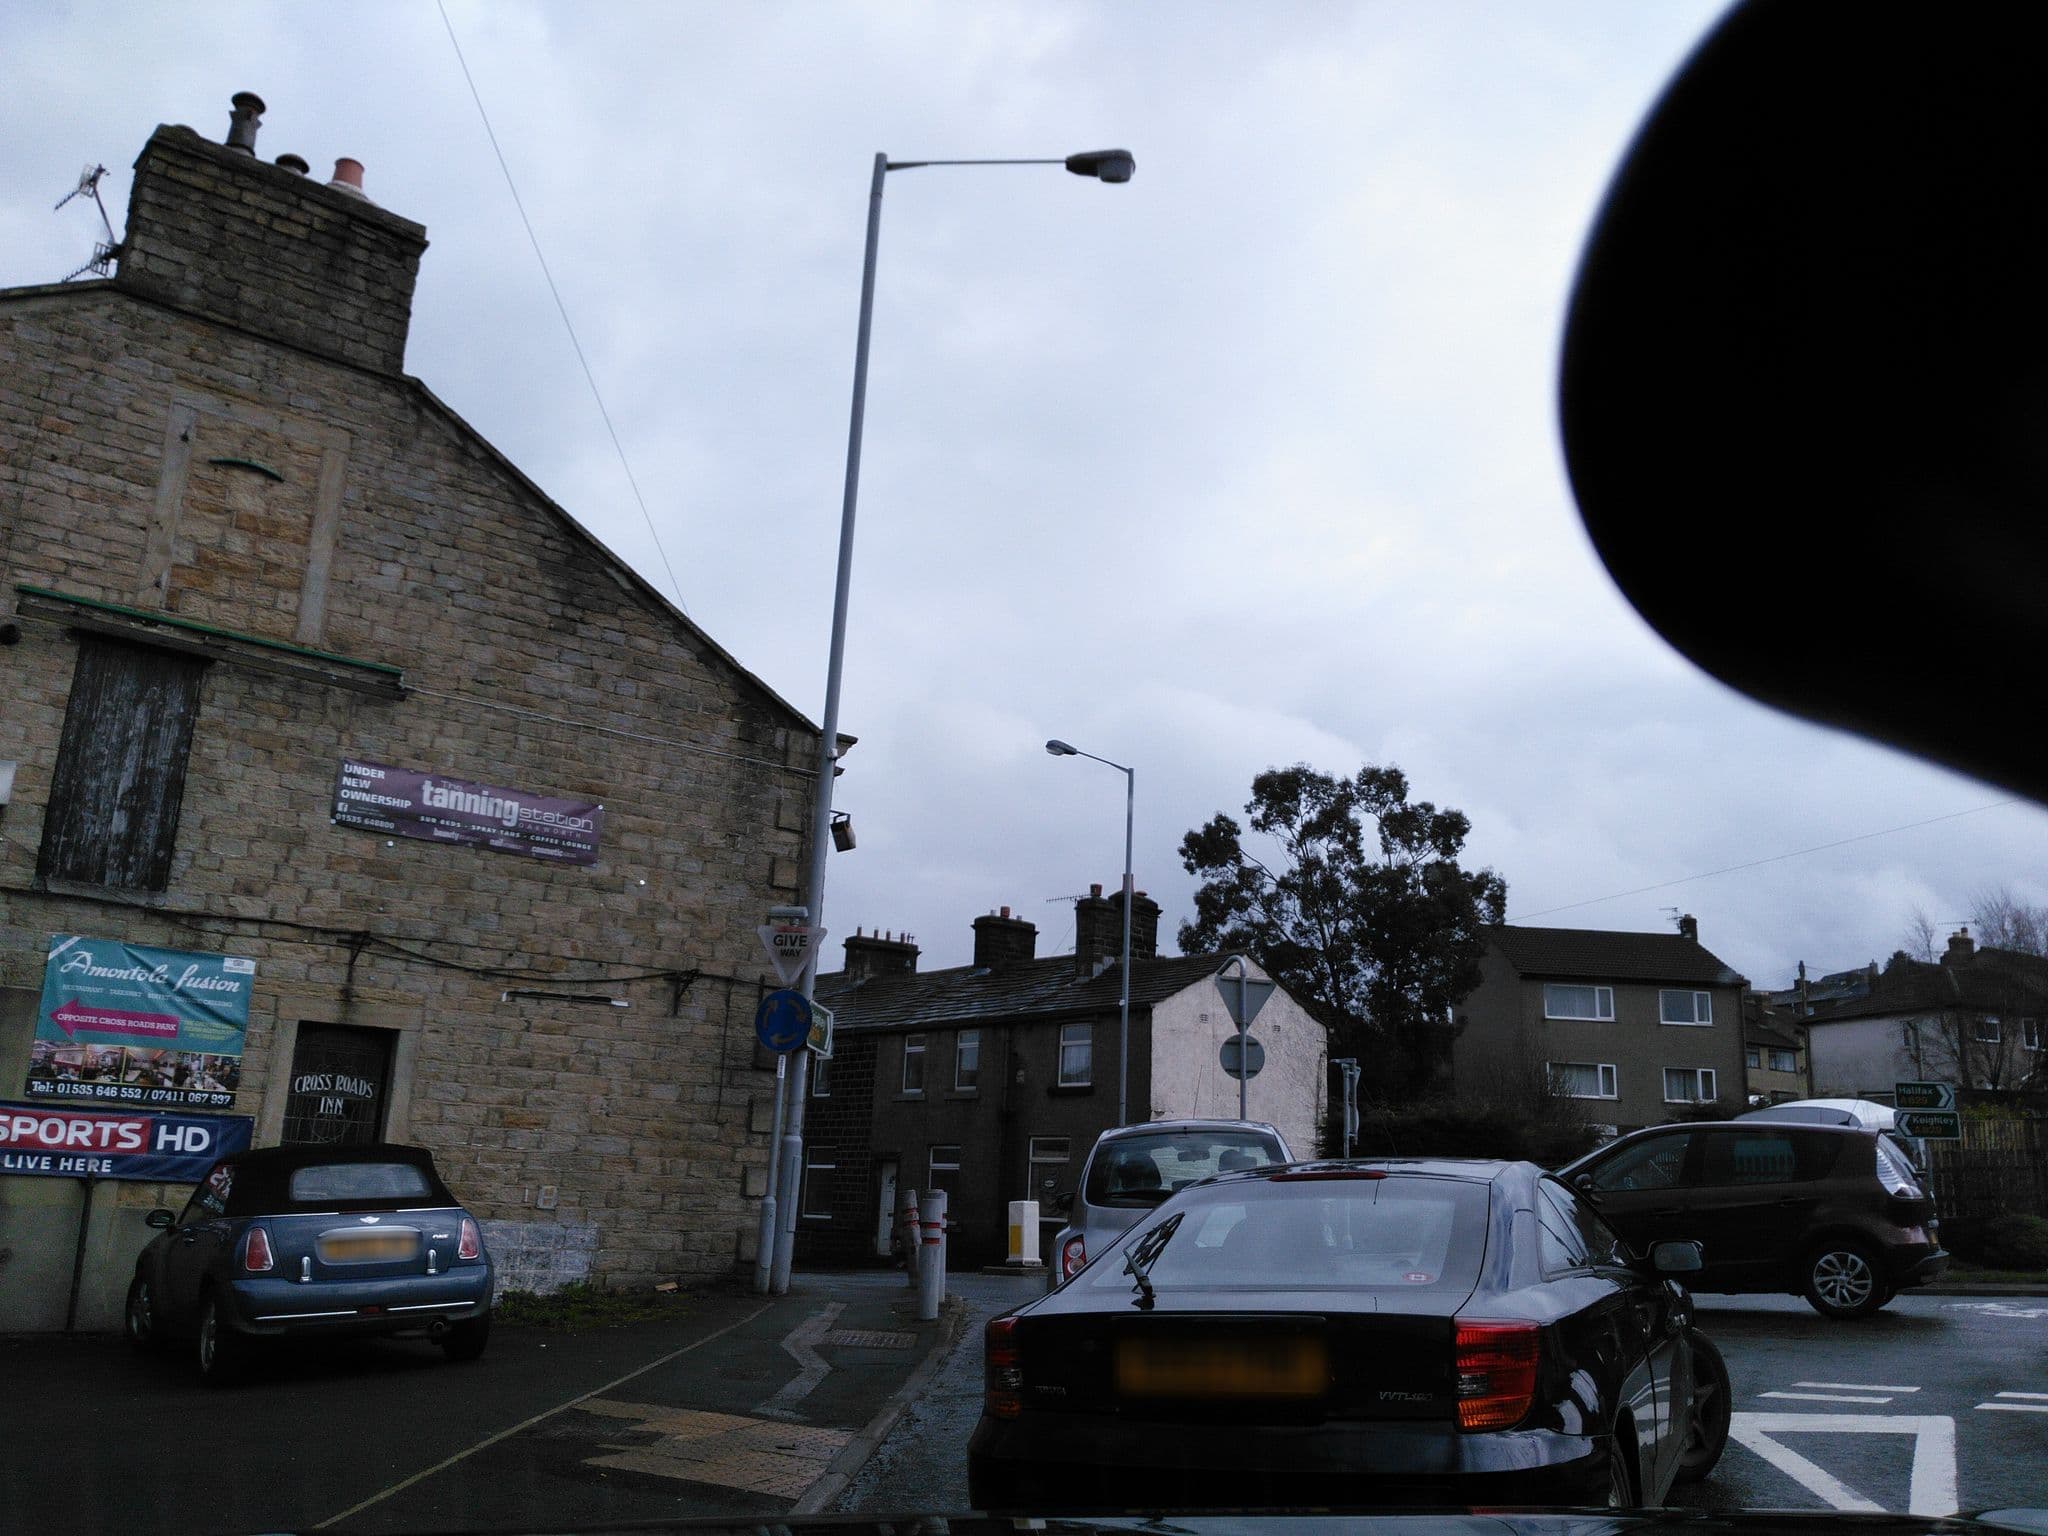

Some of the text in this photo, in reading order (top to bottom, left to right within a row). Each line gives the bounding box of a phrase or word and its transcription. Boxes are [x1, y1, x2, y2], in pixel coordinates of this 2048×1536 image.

[344, 763, 386, 780] UNDER
[342, 776, 372, 789] NEW
[340, 789, 412, 809] OWNERSHIP
[422, 780, 594, 831] tanning station
[530, 834, 560, 845] COFFEE
[562, 840, 592, 851] LOUNGE
[773, 934, 809, 947] GIVE
[780, 949, 802, 958] WAY
[172, 964, 242, 994] fusion
[57, 1013, 98, 1024] OPPOSITE
[99, 1016, 127, 1026] CROSS
[127, 1019, 155, 1029] ROADS
[156, 1022, 177, 1031] PARK
[31, 1080, 54, 1093] Tel:
[57, 1083, 94, 1096] 01535
[96, 1086, 118, 1097] 646
[120, 1087, 142, 1100] 552
[151, 1089, 185, 1102] 07411
[188, 1092, 208, 1104] 067
[210, 1094, 232, 1106] 937
[295, 1074, 374, 1098] CROSS ROADS
[320, 1097, 344, 1114] INN
[156, 1124, 211, 1153] HD
[4, 1154, 113, 1173] LIVE HERE
